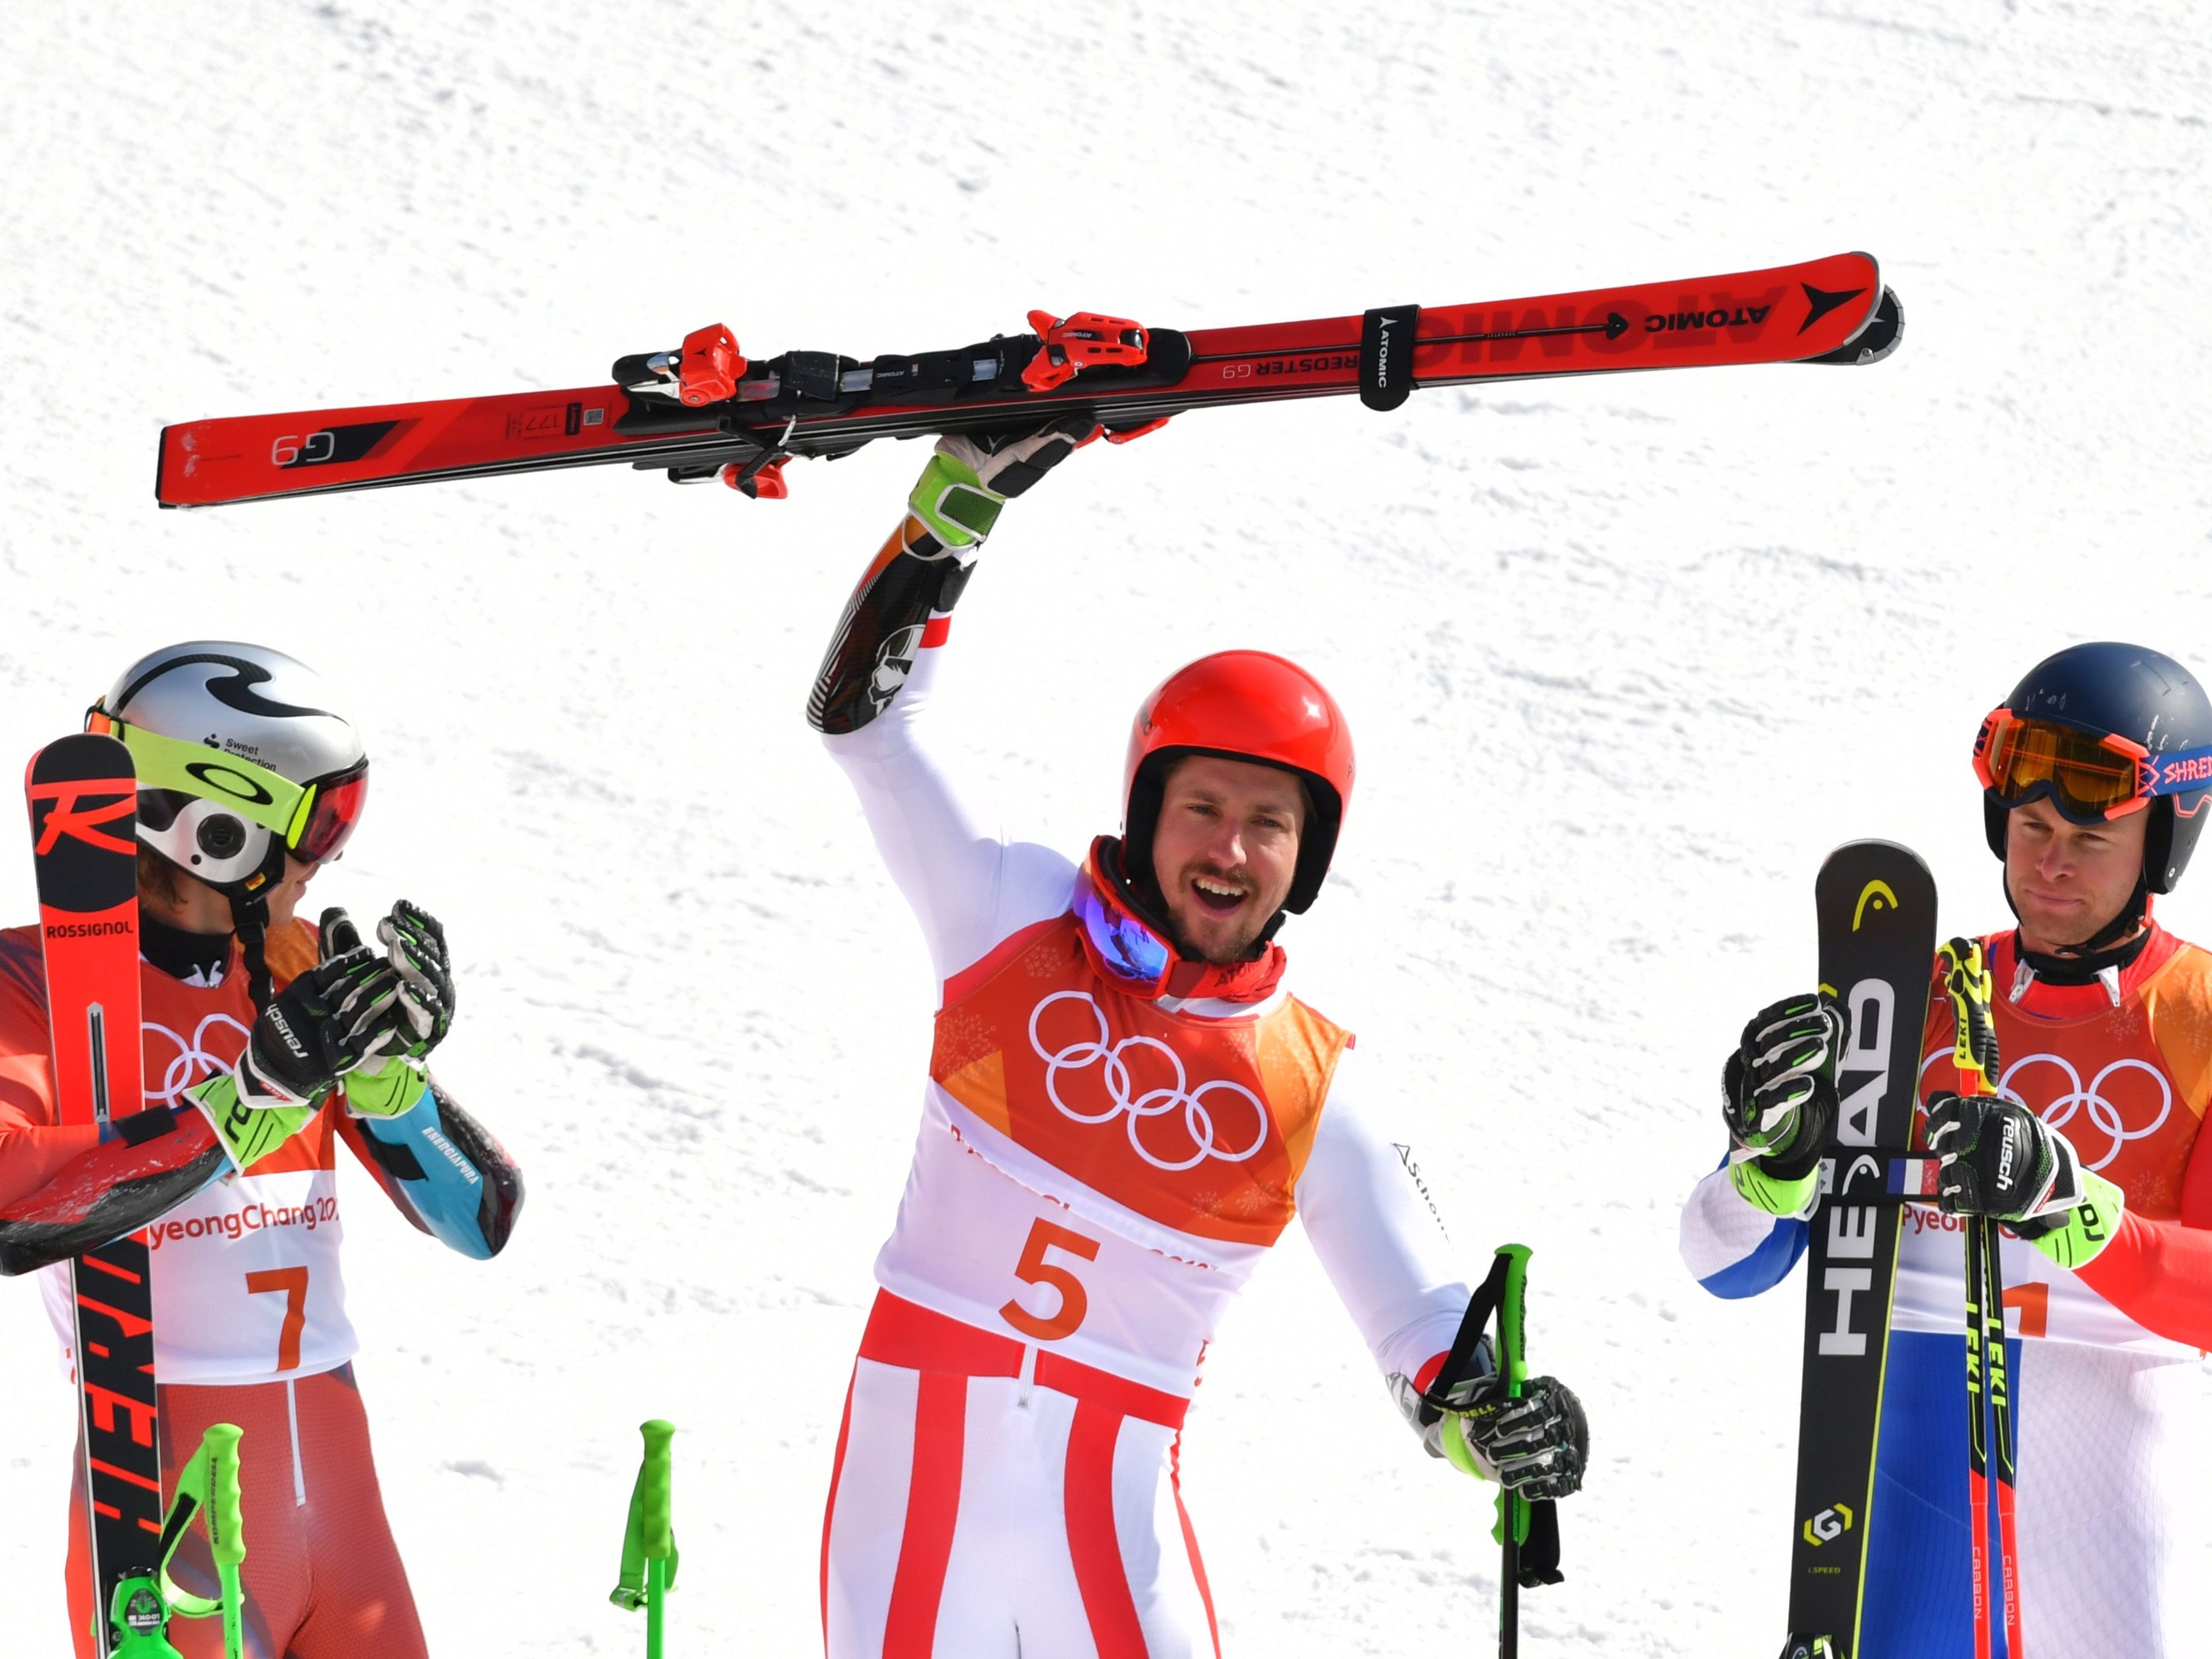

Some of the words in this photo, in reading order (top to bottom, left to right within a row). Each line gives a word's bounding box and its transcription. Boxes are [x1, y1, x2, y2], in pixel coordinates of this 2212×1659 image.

[1644, 303, 1771, 334] ATOMIC
[1222, 364, 1252, 379] G9
[1256, 355, 1359, 376] REDSTER
[1378, 329, 1389, 388] ATOMIC
[526, 413, 560, 431] 177
[271, 431, 335, 467] G9
[226, 738, 259, 756] Sweet
[47, 921, 134, 939] ROSSIGNOL
[265, 1002, 309, 1059] reusch
[1959, 1018, 1967, 1060] LEKI
[422, 1125, 480, 1185] ENERGIAPURA
[1818, 978, 1895, 1356] HEAD
[1996, 1117, 2015, 1192] reusch
[999, 1217, 1101, 1341] 5
[245, 1265, 310, 1372] 7
[2003, 1555, 2015, 1626] CARBON
[138, 1613, 160, 1621] LOOK
